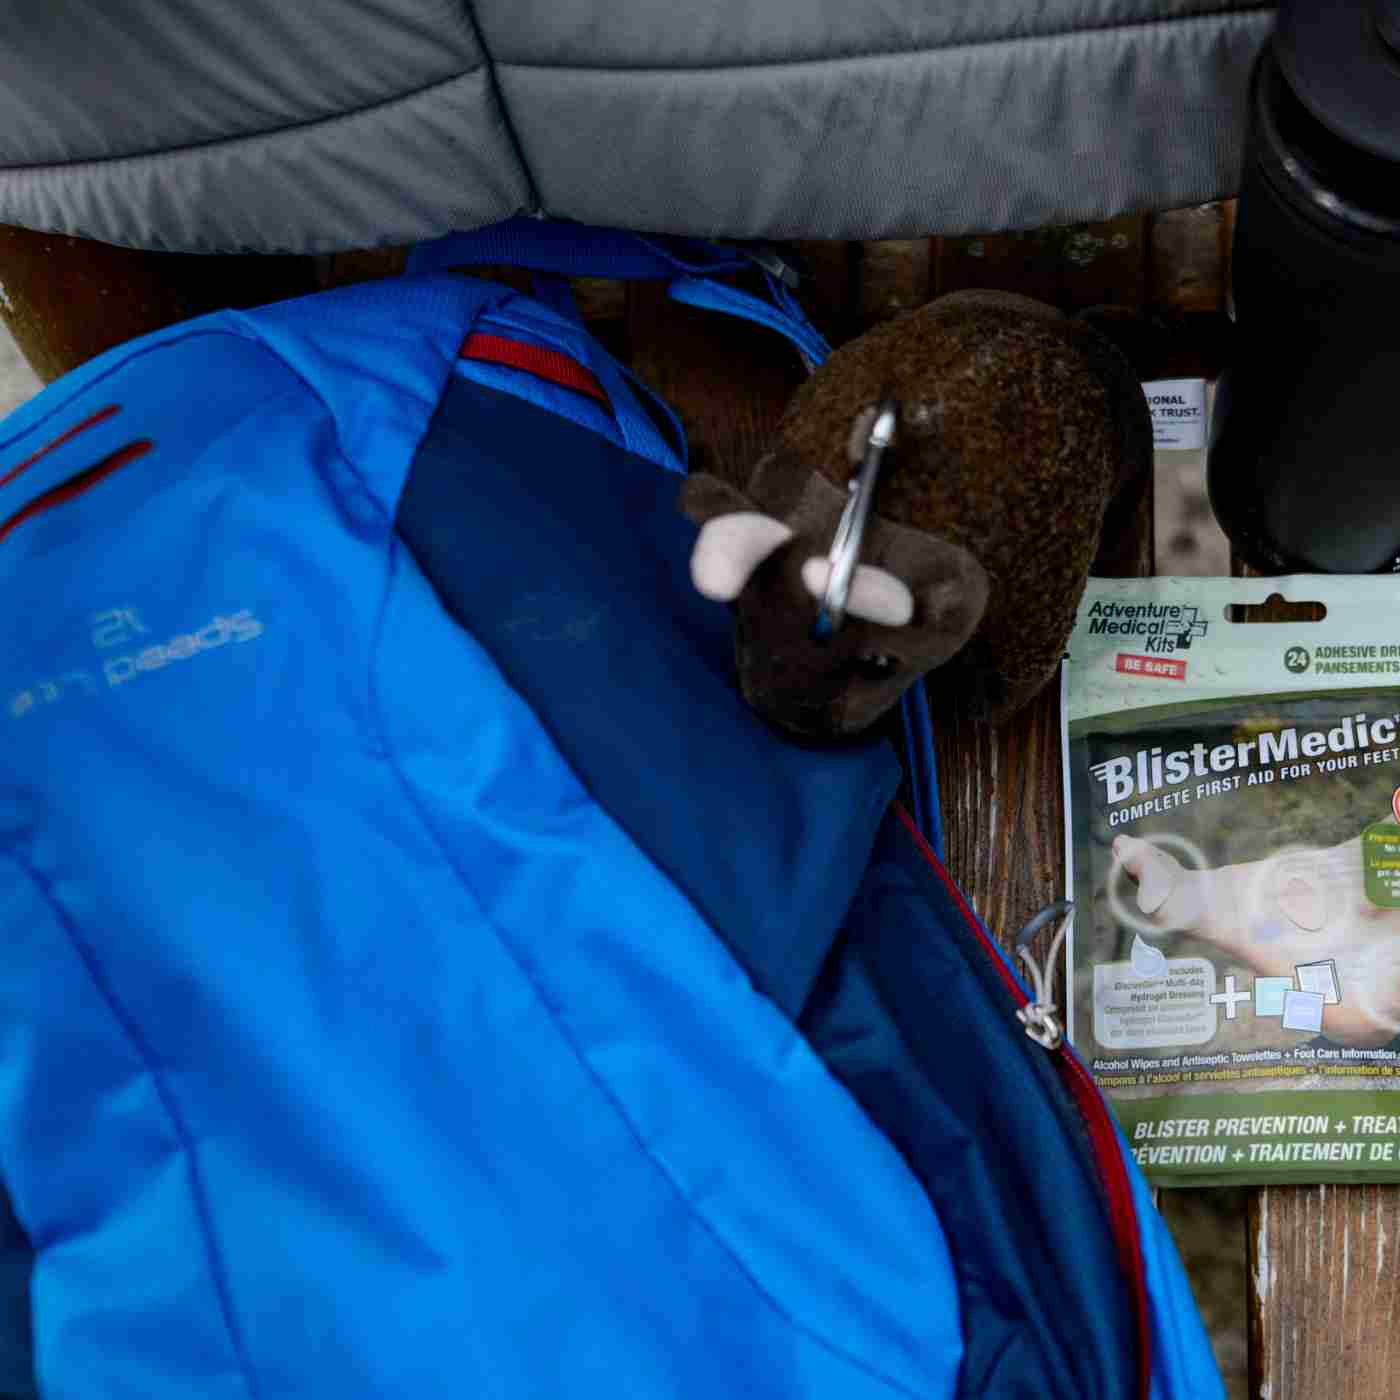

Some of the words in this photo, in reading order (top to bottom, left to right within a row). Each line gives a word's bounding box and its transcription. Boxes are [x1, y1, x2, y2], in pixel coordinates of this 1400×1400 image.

[1148, 396, 1186, 405] IONAL
[1161, 408, 1201, 417] TRUST.
[1088, 601, 1180, 618] Adventure
[1089, 618, 1166, 635] Medical
[1145, 636, 1175, 653] Kits
[1315, 645, 1376, 659] ADHESIVE
[1287, 651, 1307, 667] 24
[1315, 661, 1400, 674] PANSEMENTS
[1125, 659, 1142, 670] BE
[1144, 661, 1178, 677] SAFE
[1109, 788, 1192, 827] COMPLETE
[1196, 775, 1241, 799] FIRST
[1247, 769, 1274, 786] AID
[1280, 762, 1313, 780] FOR
[1316, 755, 1358, 774] YOUR
[1363, 747, 1400, 766] FEET
[1093, 1059, 1129, 1071] Alcohol
[1131, 1058, 1160, 1070] Wipes
[1161, 1056, 1180, 1068] and
[1182, 1054, 1229, 1067] Antiseptic
[1293, 1049, 1316, 1060] Foot
[1317, 1049, 1341, 1060] Care
[1342, 1048, 1397, 1060] Information
[1134, 1119, 1210, 1140] BLISTER
[1214, 1115, 1329, 1137] PREVENTION
[1333, 1120, 1347, 1134] +
[1131, 1143, 1226, 1165] ÉVENTION
[1231, 1148, 1245, 1163] +
[1250, 1142, 1365, 1163] TRAITEMENT
[1370, 1143, 1394, 1161] DE
